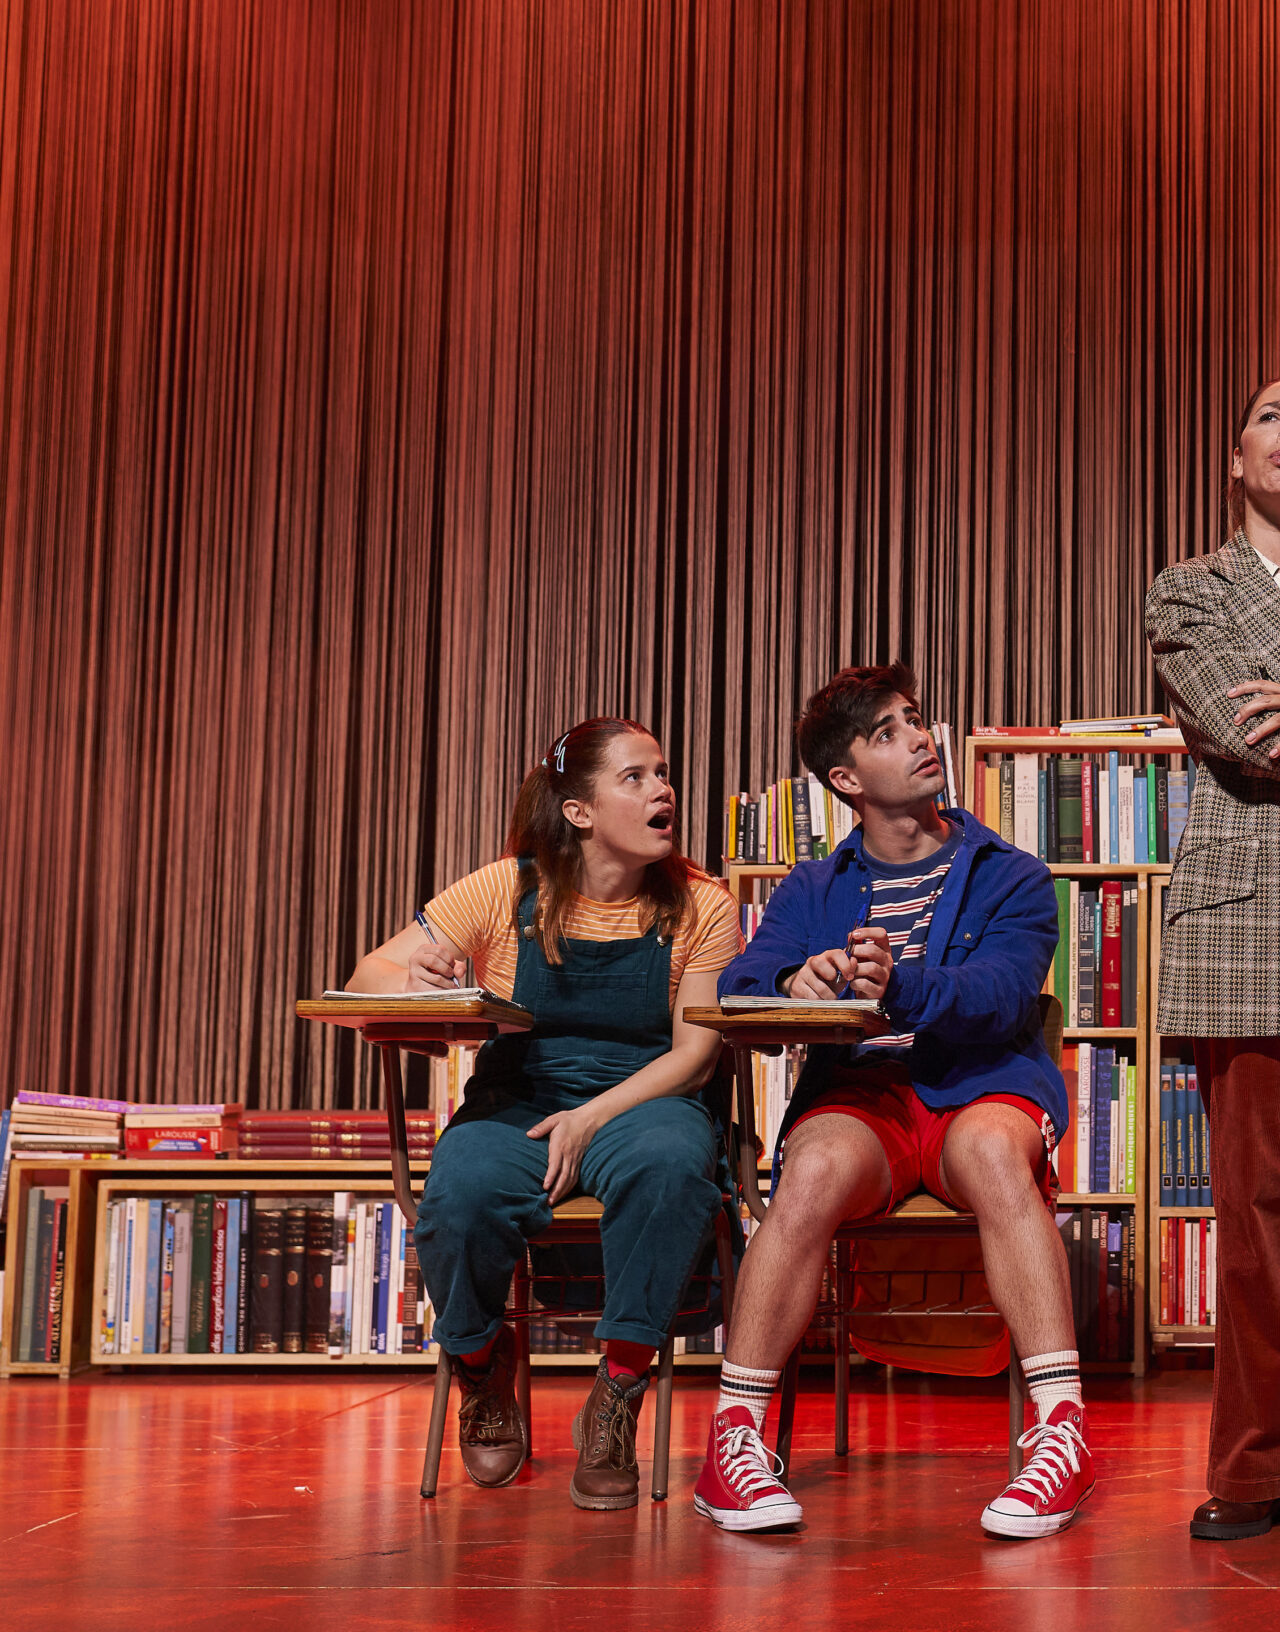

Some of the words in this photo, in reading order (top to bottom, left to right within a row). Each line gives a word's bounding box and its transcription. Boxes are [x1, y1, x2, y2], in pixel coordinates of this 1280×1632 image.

[1003, 782, 1013, 843] NSURGENT
[1082, 1056, 1090, 1096] LAROUSSE
[154, 1130, 197, 1139] LAROUSSE
[216, 1200, 225, 1209] 2
